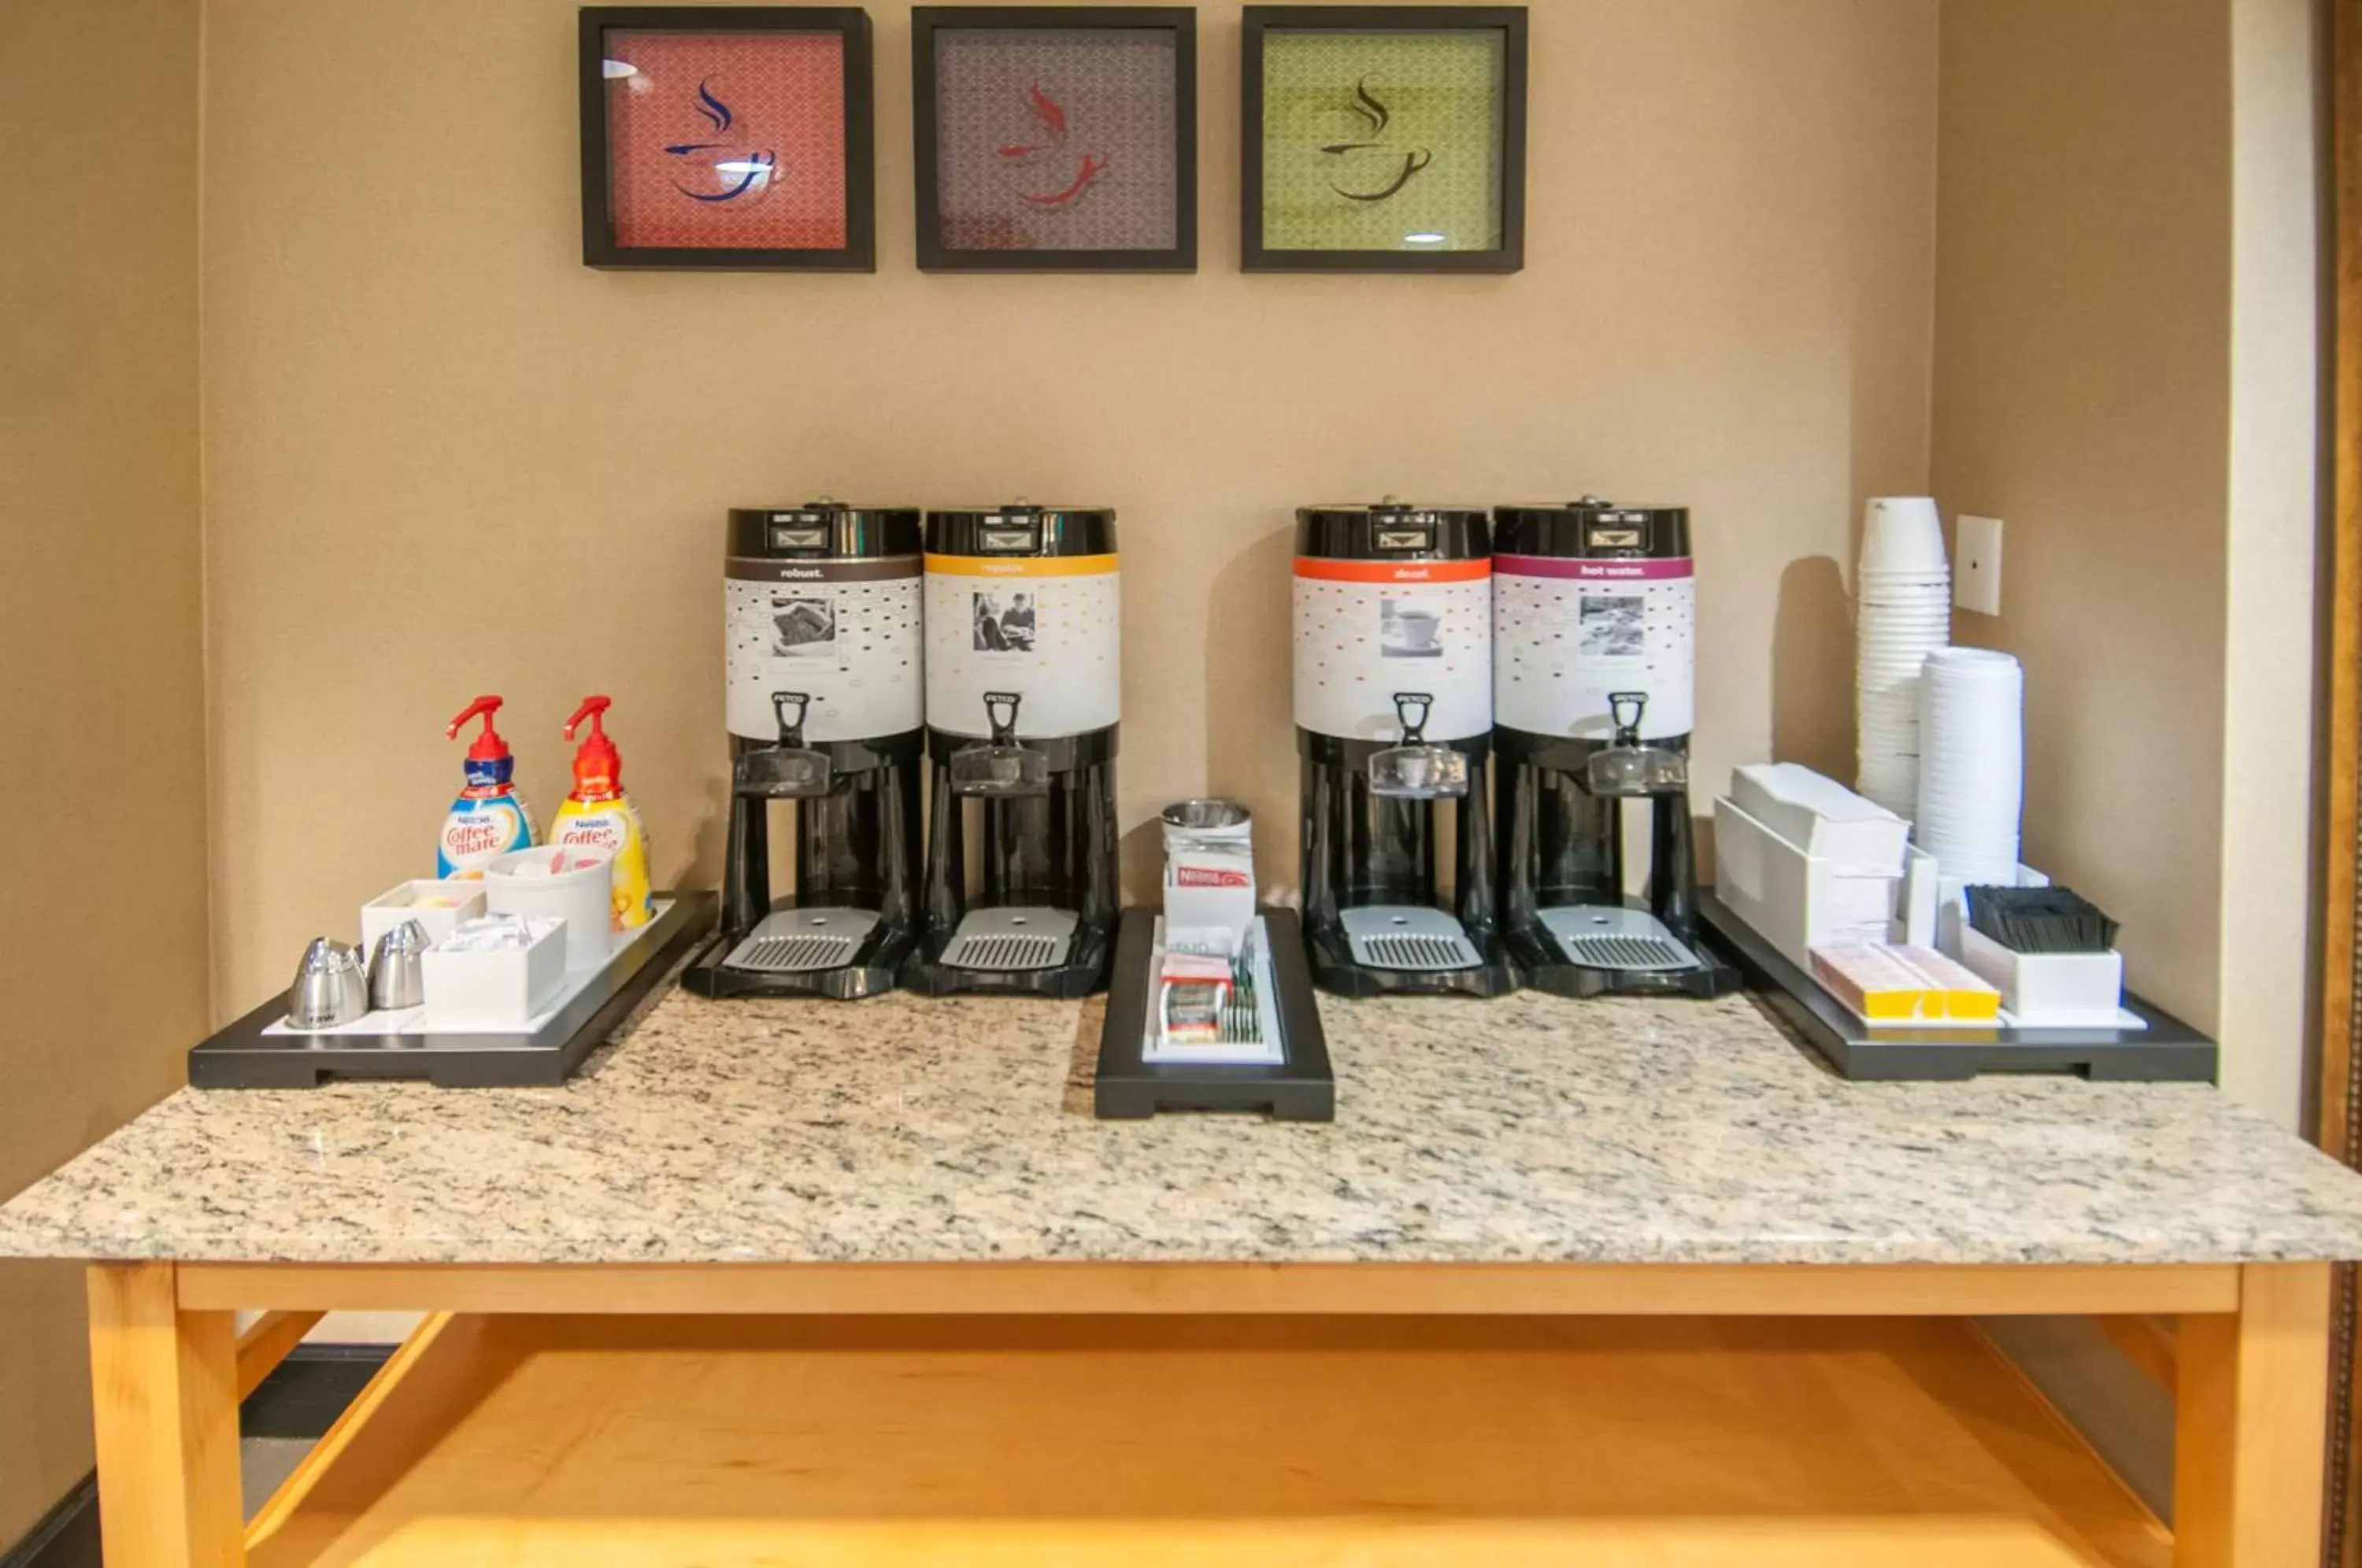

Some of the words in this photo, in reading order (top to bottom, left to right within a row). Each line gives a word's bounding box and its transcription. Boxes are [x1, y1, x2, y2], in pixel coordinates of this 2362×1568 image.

[779, 568, 825, 579] robust.
[1580, 565, 1604, 575] hot
[446, 824, 495, 846] Coffee
[456, 836, 500, 856] mate
